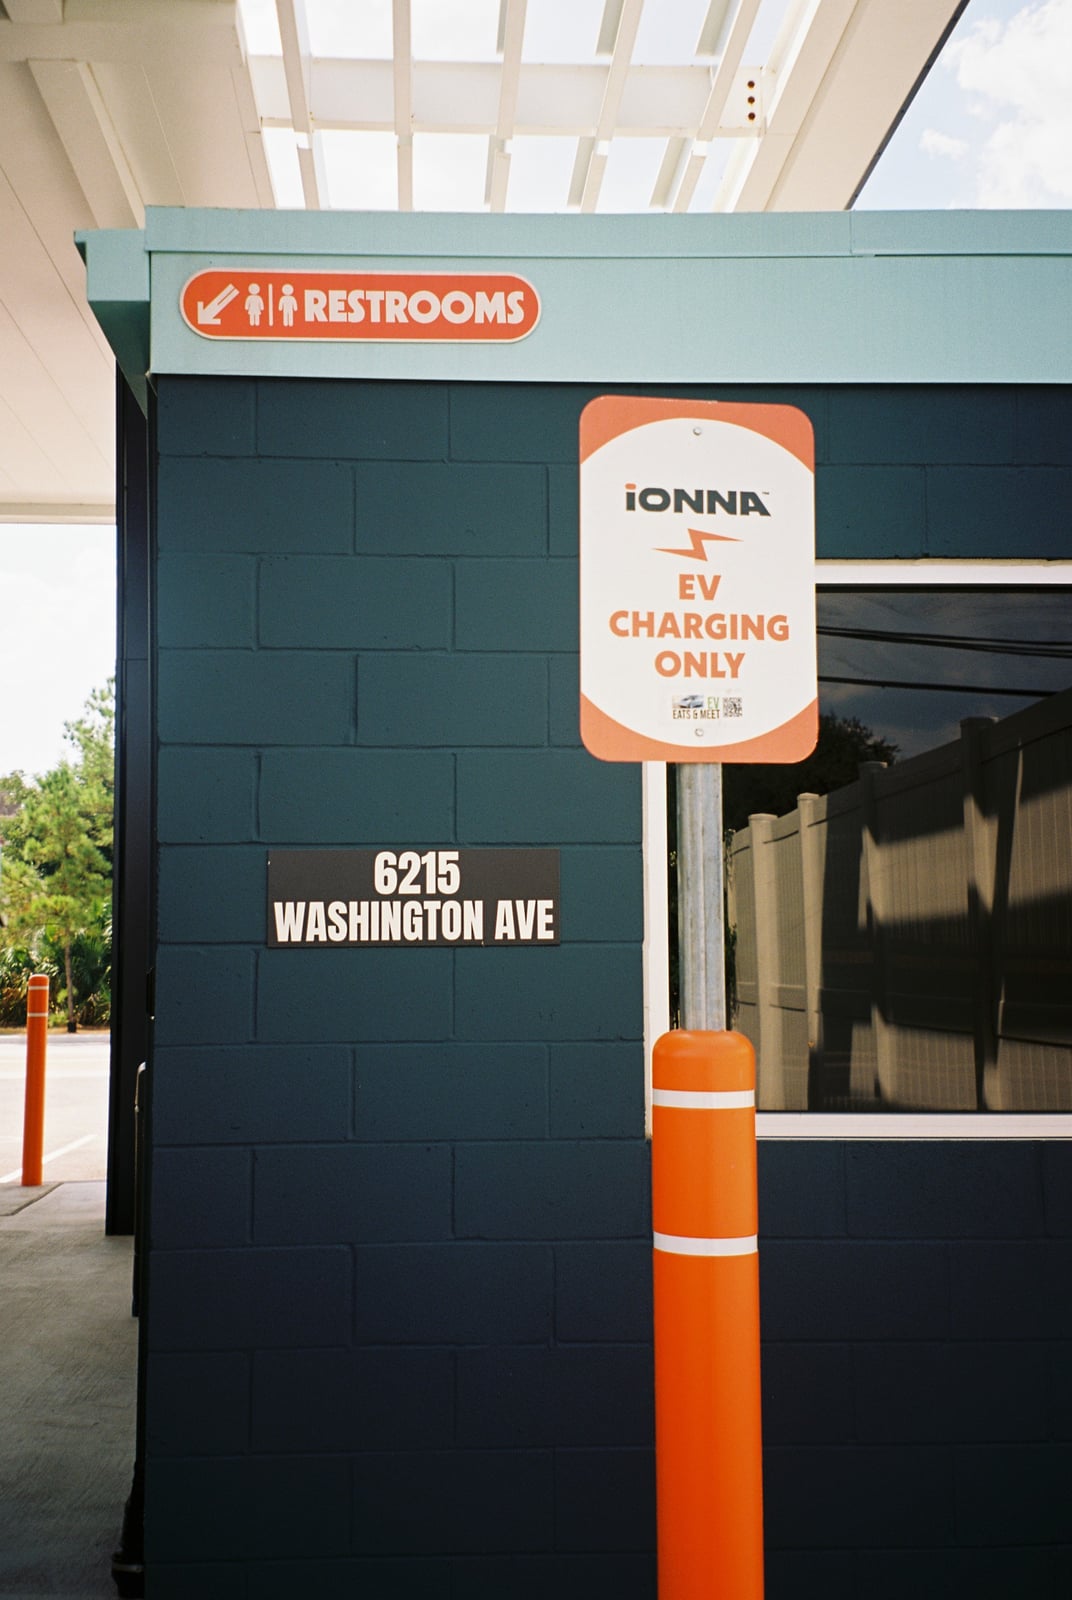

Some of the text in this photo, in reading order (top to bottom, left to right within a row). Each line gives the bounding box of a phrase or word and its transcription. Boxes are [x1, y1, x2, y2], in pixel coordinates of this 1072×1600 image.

[304, 289, 525, 324] RESTROOMS
[679, 574, 721, 601] EV
[609, 610, 790, 642] CHARGING
[655, 650, 746, 679] ONLY
[672, 709, 720, 720] EATS & MEET
[707, 696, 720, 709] EV
[374, 851, 461, 895] 6215
[273, 899, 555, 942] WASHINGTON AVE
